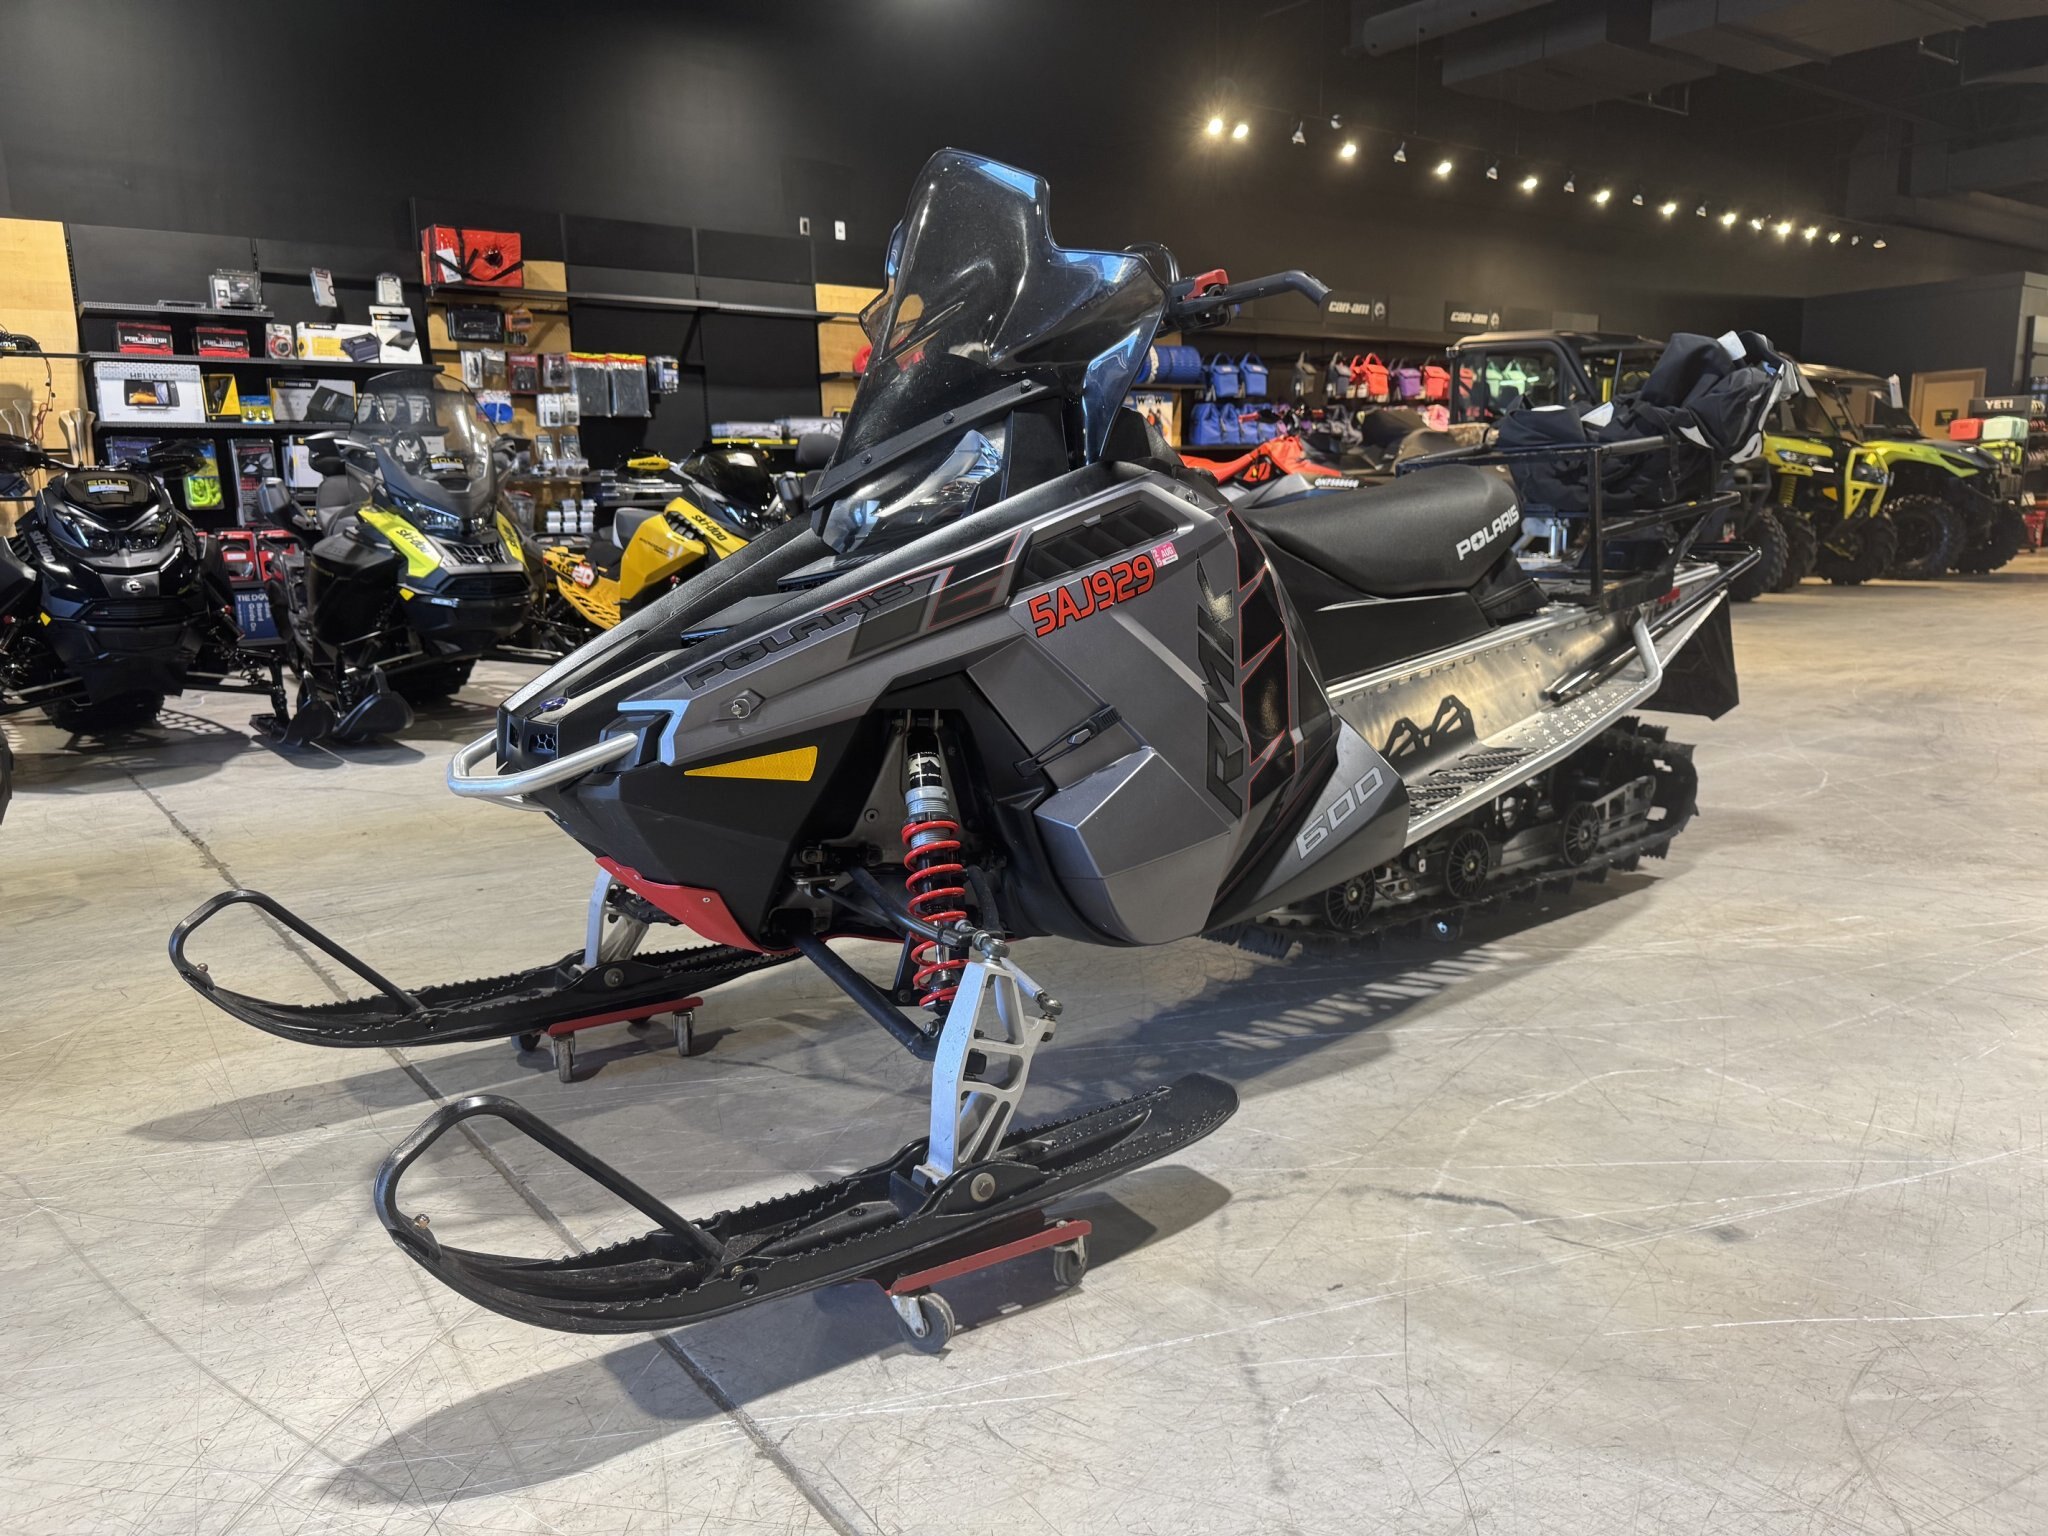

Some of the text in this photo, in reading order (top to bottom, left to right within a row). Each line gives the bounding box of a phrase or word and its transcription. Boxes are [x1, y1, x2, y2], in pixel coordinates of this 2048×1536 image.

[1985, 399, 2013, 410] YETI
[87, 479, 129, 487] SOLD
[692, 514, 728, 542] ski-doo
[1456, 504, 1519, 561] POLARIS
[1161, 546, 1173, 558] AUG
[1028, 554, 1156, 638] 5AJ929
[683, 580, 914, 690] POLARIS
[1295, 766, 1385, 861] 600
